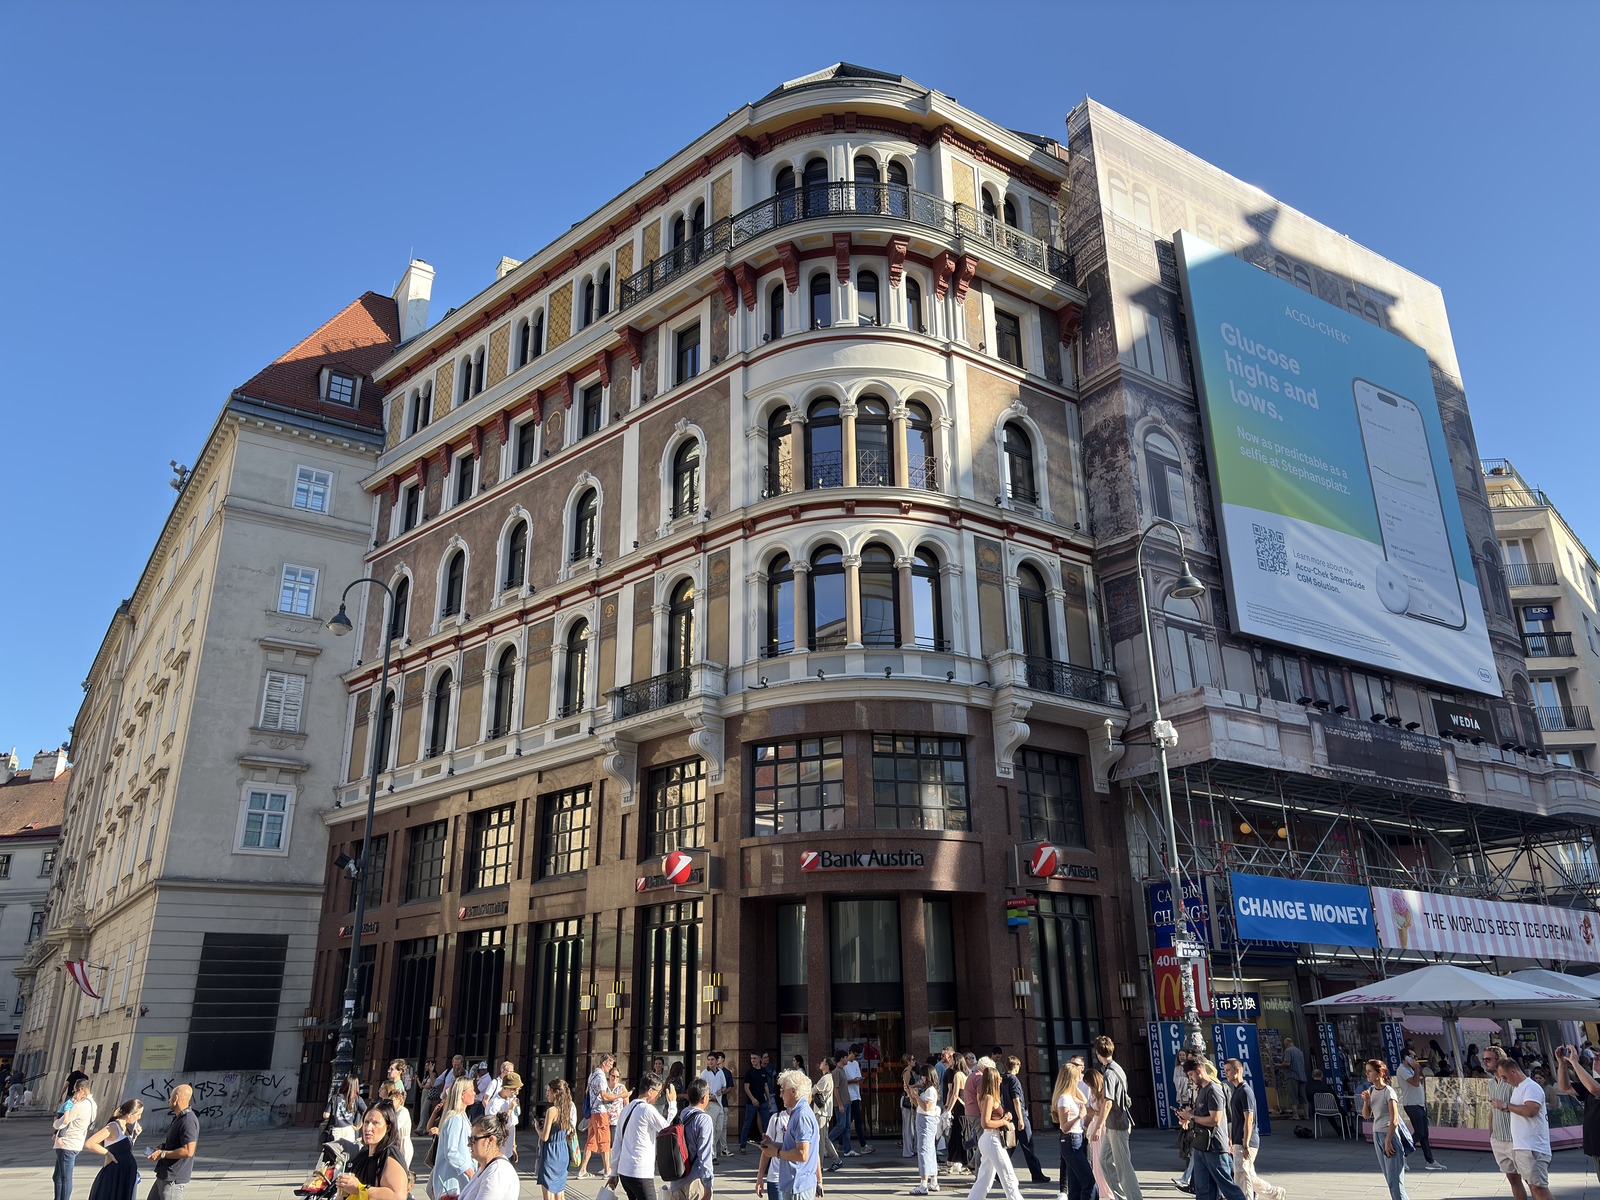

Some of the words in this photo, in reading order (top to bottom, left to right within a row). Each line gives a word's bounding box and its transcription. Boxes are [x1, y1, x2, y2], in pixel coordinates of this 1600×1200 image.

[1221, 322, 1301, 375] Glucose
[1224, 349, 1280, 393] highs
[1283, 381, 1320, 410] and
[1229, 379, 1284, 421] lows.
[1236, 425, 1260, 444] Now
[1261, 438, 1273, 450] as
[1274, 443, 1329, 472] predictable
[1330, 465, 1341, 477] as
[1341, 469, 1349, 480] a
[1240, 446, 1268, 464] selfie
[1270, 457, 1280, 469] at
[1281, 459, 1351, 496] Stephansplatz.
[1293, 550, 1311, 562] Learn
[1311, 556, 1326, 567] more
[1326, 561, 1344, 573] about
[1343, 566, 1354, 577] the
[1295, 562, 1330, 579] Accu-Chek
[1329, 573, 1366, 591] SmartGuide
[1296, 573, 1313, 585] CGM
[821, 849, 864, 868] Bank
[867, 849, 925, 867] Austria
[1157, 885, 1200, 903] CABIO
[1238, 896, 1308, 921] CHANGE
[1309, 903, 1368, 926] MONEY
[1424, 912, 1447, 931] THE
[1446, 914, 1495, 935] WORLD'S
[1496, 921, 1521, 937] BEST
[1523, 922, 1540, 939] ICE
[1542, 924, 1573, 942] CREAM
[1318, 1025, 1331, 1070] CHANGE
[1327, 1025, 1338, 1069] CHANGE
[1384, 1025, 1398, 1071] CHANGE
[1150, 1024, 1161, 1074] CHANGE
[1156, 1083, 1167, 1126] MONEY
